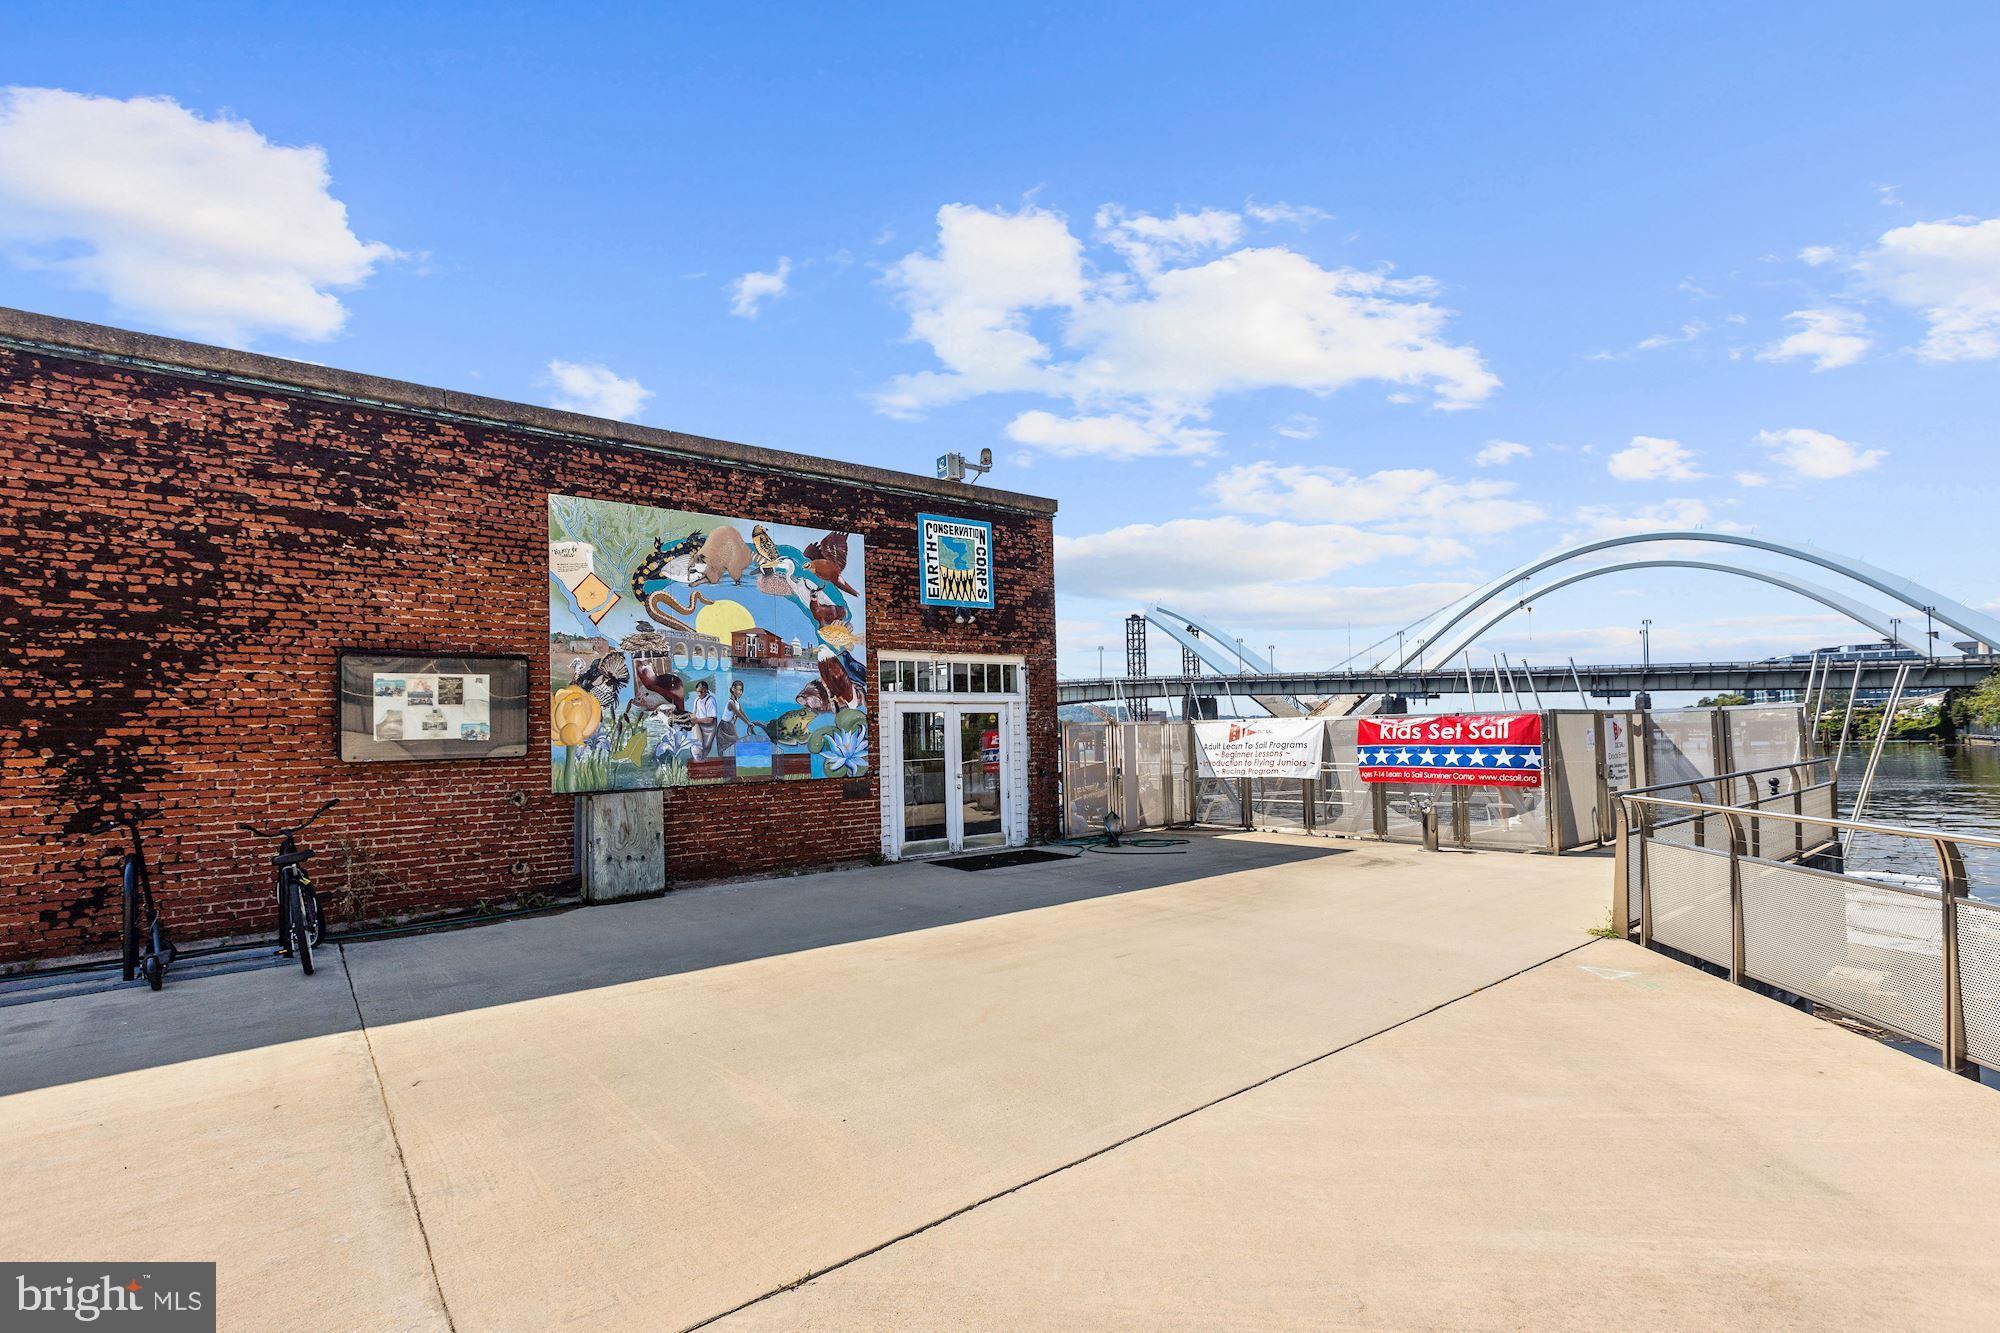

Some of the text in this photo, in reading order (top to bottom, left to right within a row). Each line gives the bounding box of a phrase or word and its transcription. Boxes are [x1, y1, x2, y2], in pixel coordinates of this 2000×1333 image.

[925, 522, 986, 545] CONSERVATION
[925, 541, 940, 598] EARTH
[976, 546, 988, 600] CORPS
[1380, 720, 1509, 740] Kids Set Sail
[1245, 742, 1254, 750] To
[1255, 741, 1268, 749] Sail
[1269, 741, 1308, 750] Programs
[1221, 750, 1283, 759] Beginner Lessons
[1254, 759, 1275, 767] Flying
[1277, 758, 1307, 767] Juniors
[1403, 770, 1410, 778] to
[1452, 772, 1475, 781] Camp
[1478, 773, 1538, 783] www.dcsail.org
